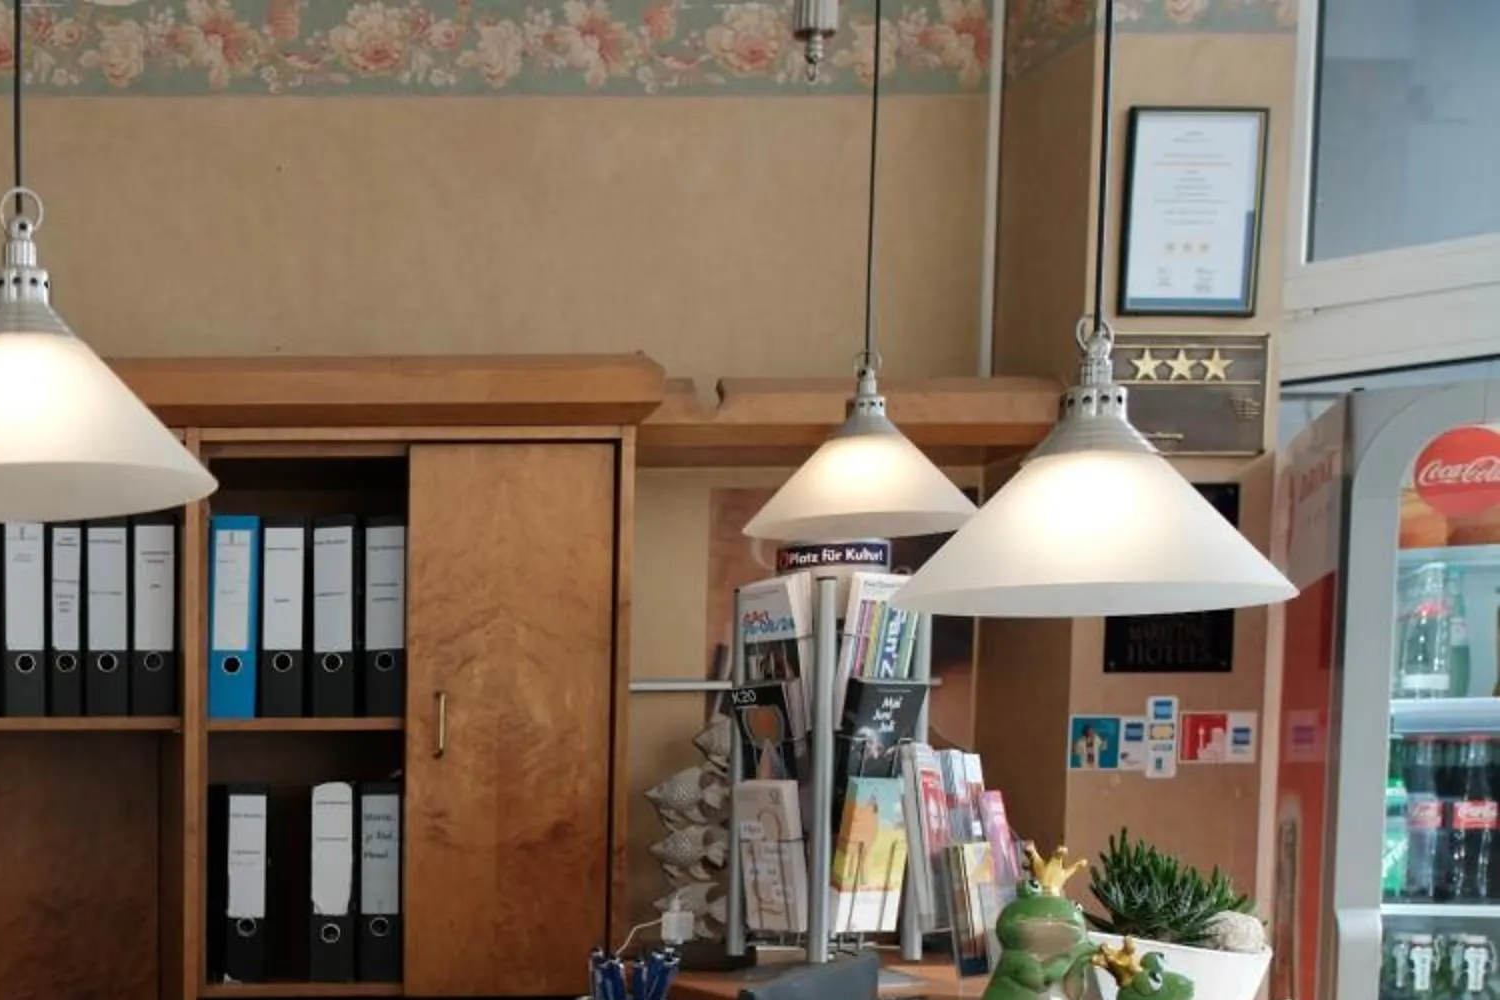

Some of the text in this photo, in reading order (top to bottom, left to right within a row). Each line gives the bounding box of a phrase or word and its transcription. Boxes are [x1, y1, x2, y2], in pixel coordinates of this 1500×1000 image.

[789, 546, 884, 566] Platz für Kultur!
